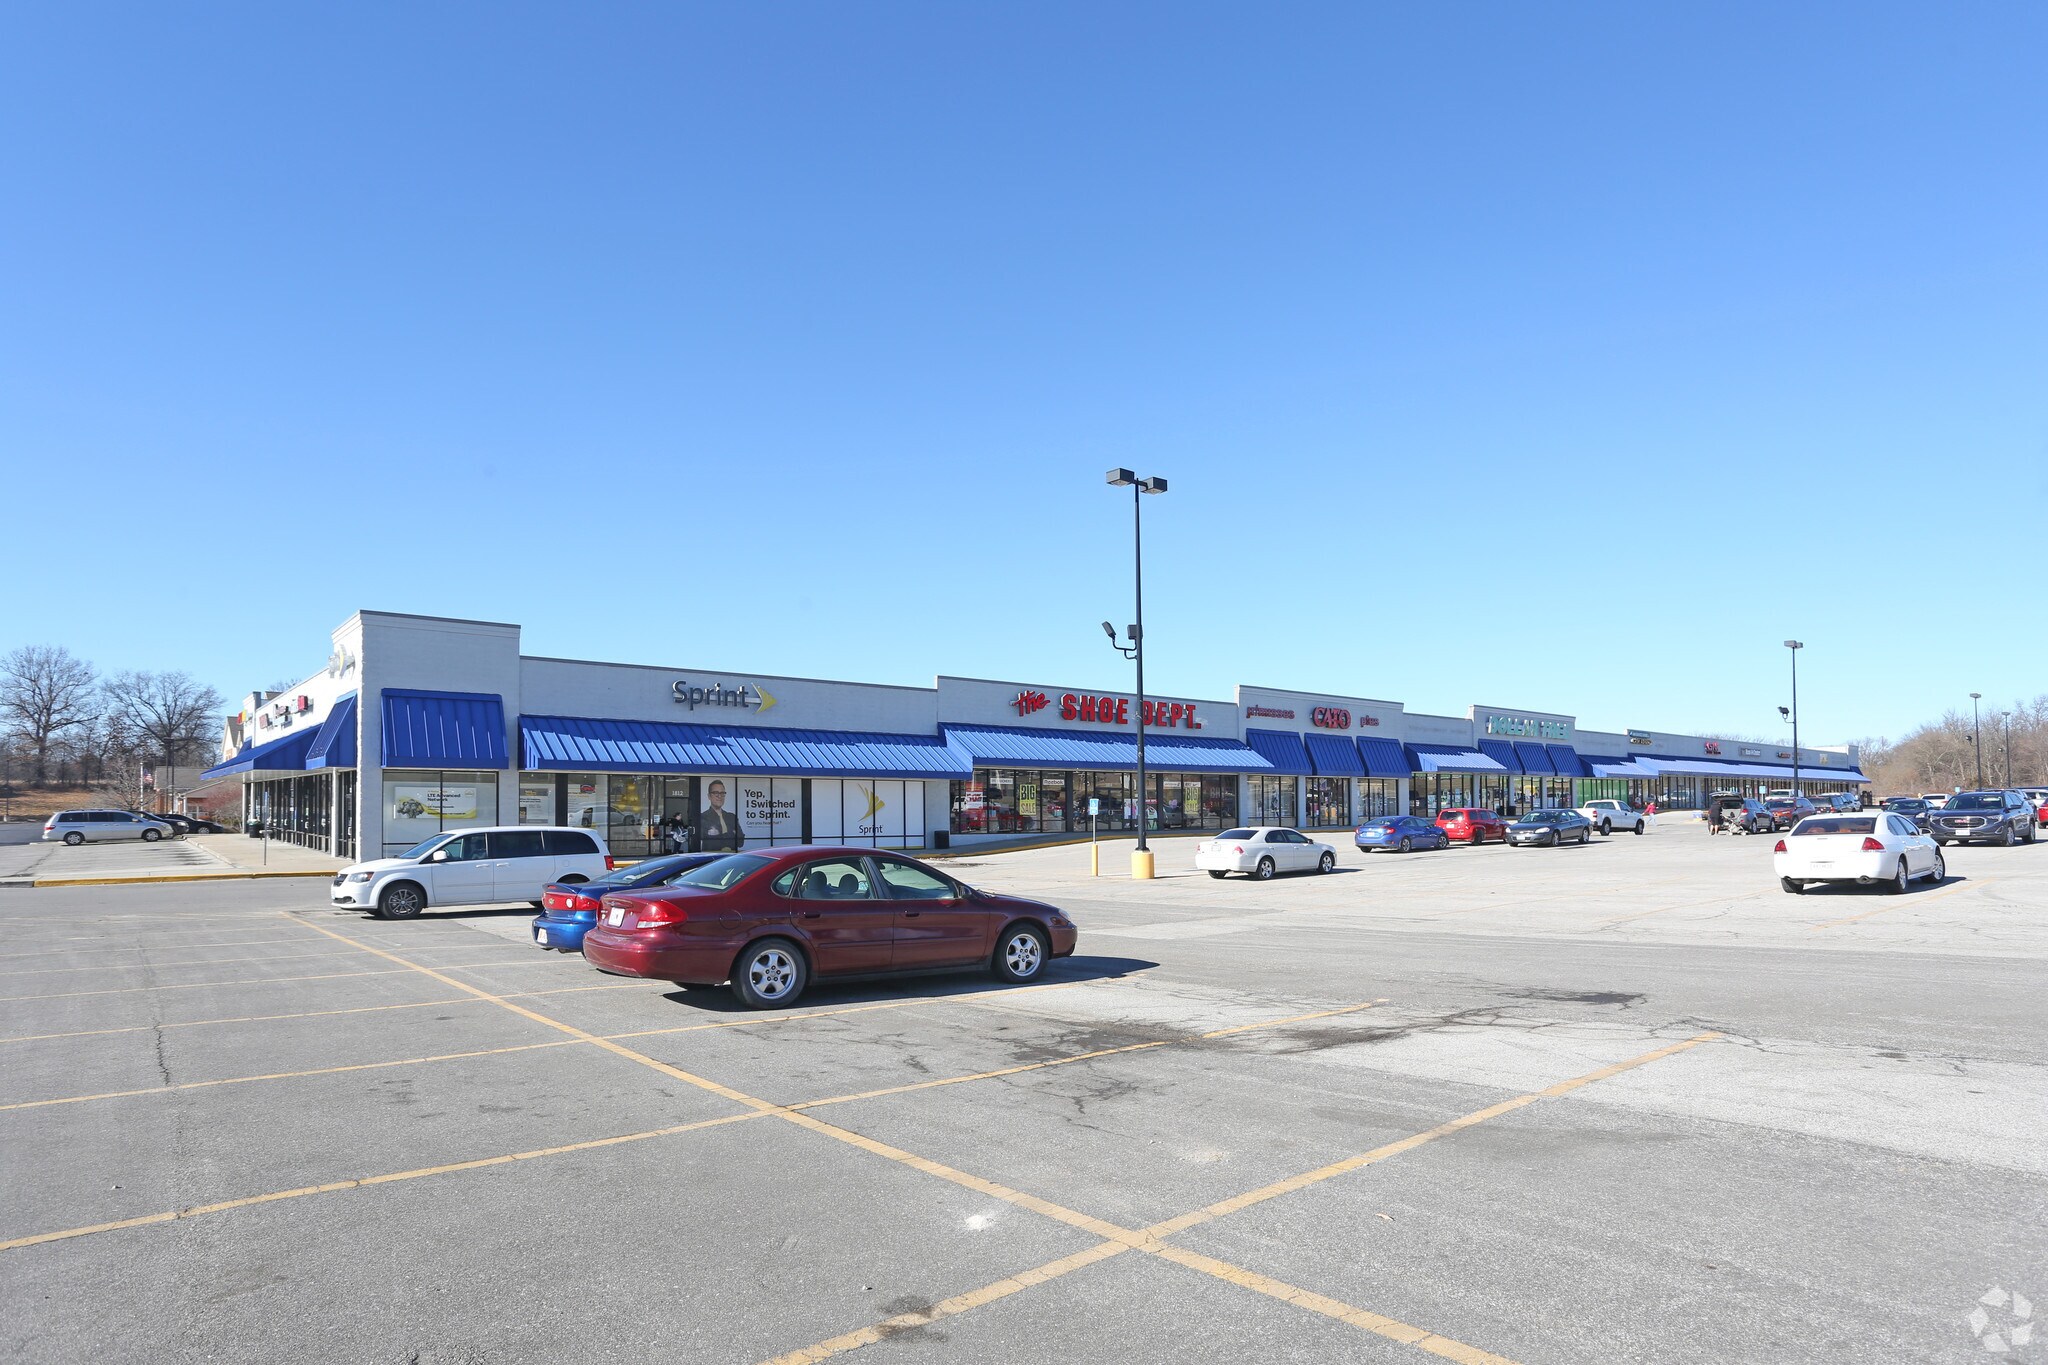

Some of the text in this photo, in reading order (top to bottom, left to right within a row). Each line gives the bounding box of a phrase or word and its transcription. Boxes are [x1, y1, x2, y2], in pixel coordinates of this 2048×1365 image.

[672, 679, 749, 711] Sprint
[1013, 690, 1202, 729] the SHOE DEPT.
[1312, 706, 1352, 729] CATO
[1360, 715, 1380, 727] plus
[1487, 715, 1539, 737] DOLLAR
[744, 789, 765, 799] Yep,
[1021, 785, 1035, 800] BIG
[746, 800, 795, 808] I Switched
[1021, 802, 1036, 814] SALE
[746, 810, 791, 820] to Sprint.
